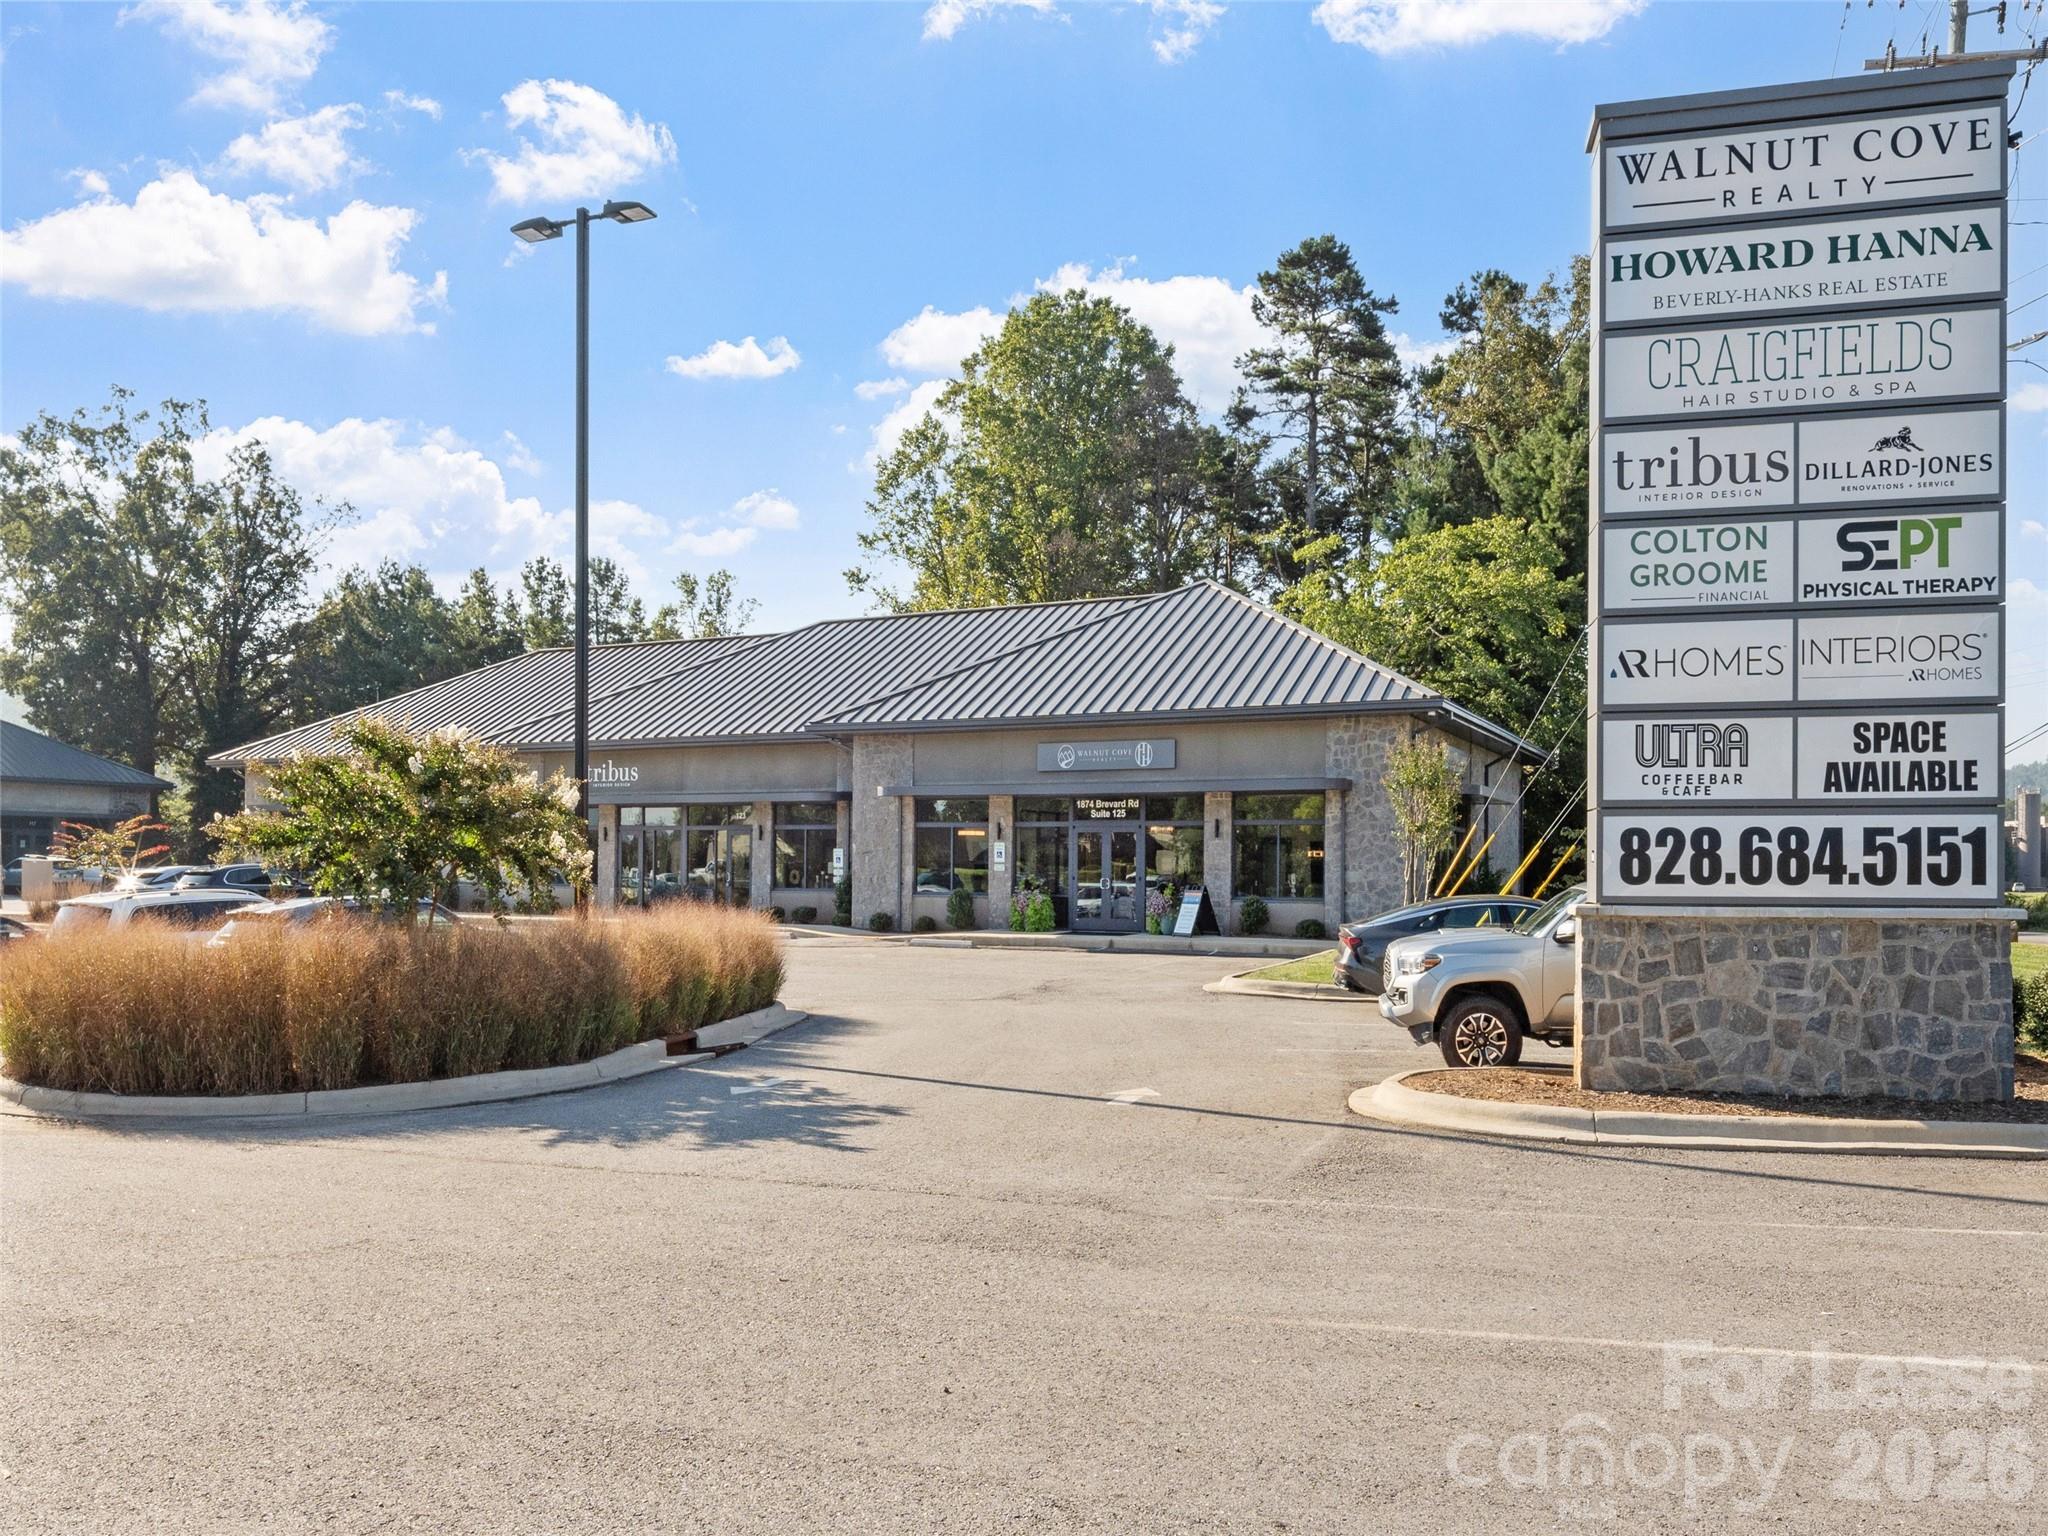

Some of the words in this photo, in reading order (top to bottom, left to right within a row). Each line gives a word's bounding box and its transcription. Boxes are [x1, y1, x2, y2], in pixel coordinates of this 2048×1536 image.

[1617, 133, 1830, 185] WALNUT
[1853, 118, 1993, 162] COVE
[1722, 175, 1877, 208] REALTY
[1611, 239, 1814, 283] HOWARD
[1828, 223, 1993, 264] HANNA
[1653, 283, 1812, 311] BEVERLY-HANKS
[1818, 279, 1869, 297] REAL
[1875, 272, 1949, 293] ESTATE
[1648, 317, 1954, 390] CRAIGFIELDS
[1682, 392, 1737, 409] HAIR
[1749, 385, 1835, 404] STUDIO
[1849, 383, 1861, 398] &
[1874, 380, 1918, 396] SPA
[1612, 436, 1790, 491] tribus
[1805, 453, 1993, 482] DILLARD-JONES
[1638, 490, 1705, 503] INTERIOR
[1711, 488, 1763, 500] DESIGN
[1840, 482, 1906, 493] RENOVATIONS
[1917, 479, 1956, 489] SERVICE
[1630, 525, 1768, 556] COLTON
[1836, 516, 1963, 573] SEPT
[1630, 559, 1768, 588] GROOME
[1803, 579, 1899, 599] PHYSICAL
[1904, 576, 1997, 595] THERAPY
[1698, 590, 1769, 603] FINANCIAL
[1801, 633, 1982, 666] INTERIORS
[1635, 723, 1749, 768] ULTRA
[1853, 720, 1947, 754] SPACE
[587, 759, 639, 782] tribus
[1641, 772, 1744, 786] COFFEEBAR
[1823, 759, 1979, 793] AVAILABLE
[1076, 800, 1094, 808] 1874
[1095, 799, 1126, 808] Brevard
[1127, 799, 1139, 808] Rd
[1661, 787, 1669, 796] &
[1672, 785, 1712, 797] CAFE
[1090, 809, 1110, 818] Suite
[1112, 809, 1127, 818] 125
[1619, 826, 1988, 886] 828.684.5151
